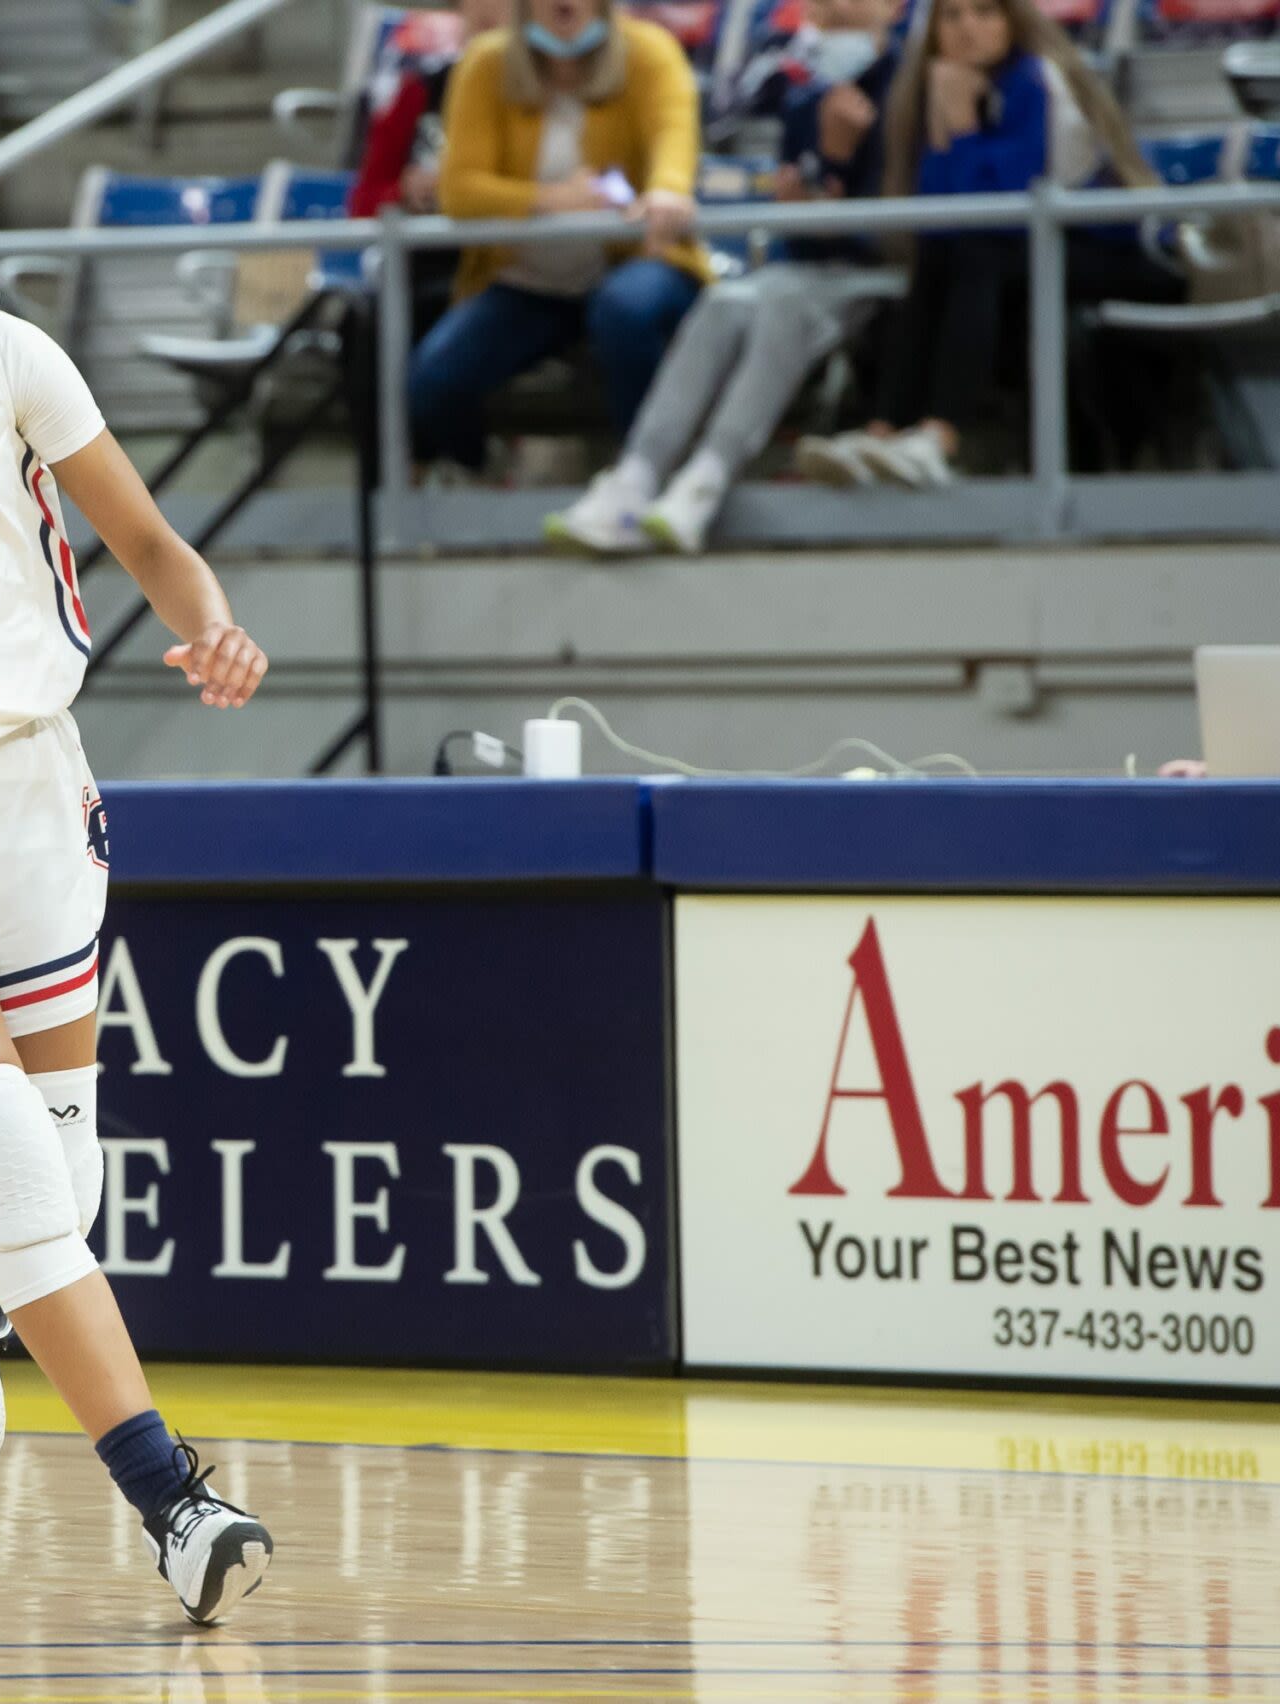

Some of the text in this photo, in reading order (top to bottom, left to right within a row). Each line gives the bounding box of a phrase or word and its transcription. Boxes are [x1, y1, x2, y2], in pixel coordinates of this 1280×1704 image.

[786, 915, 1280, 1209] Ameri
[798, 1220, 1265, 1293] Your Best News
[993, 1307, 1256, 1356] 337-433-3000
